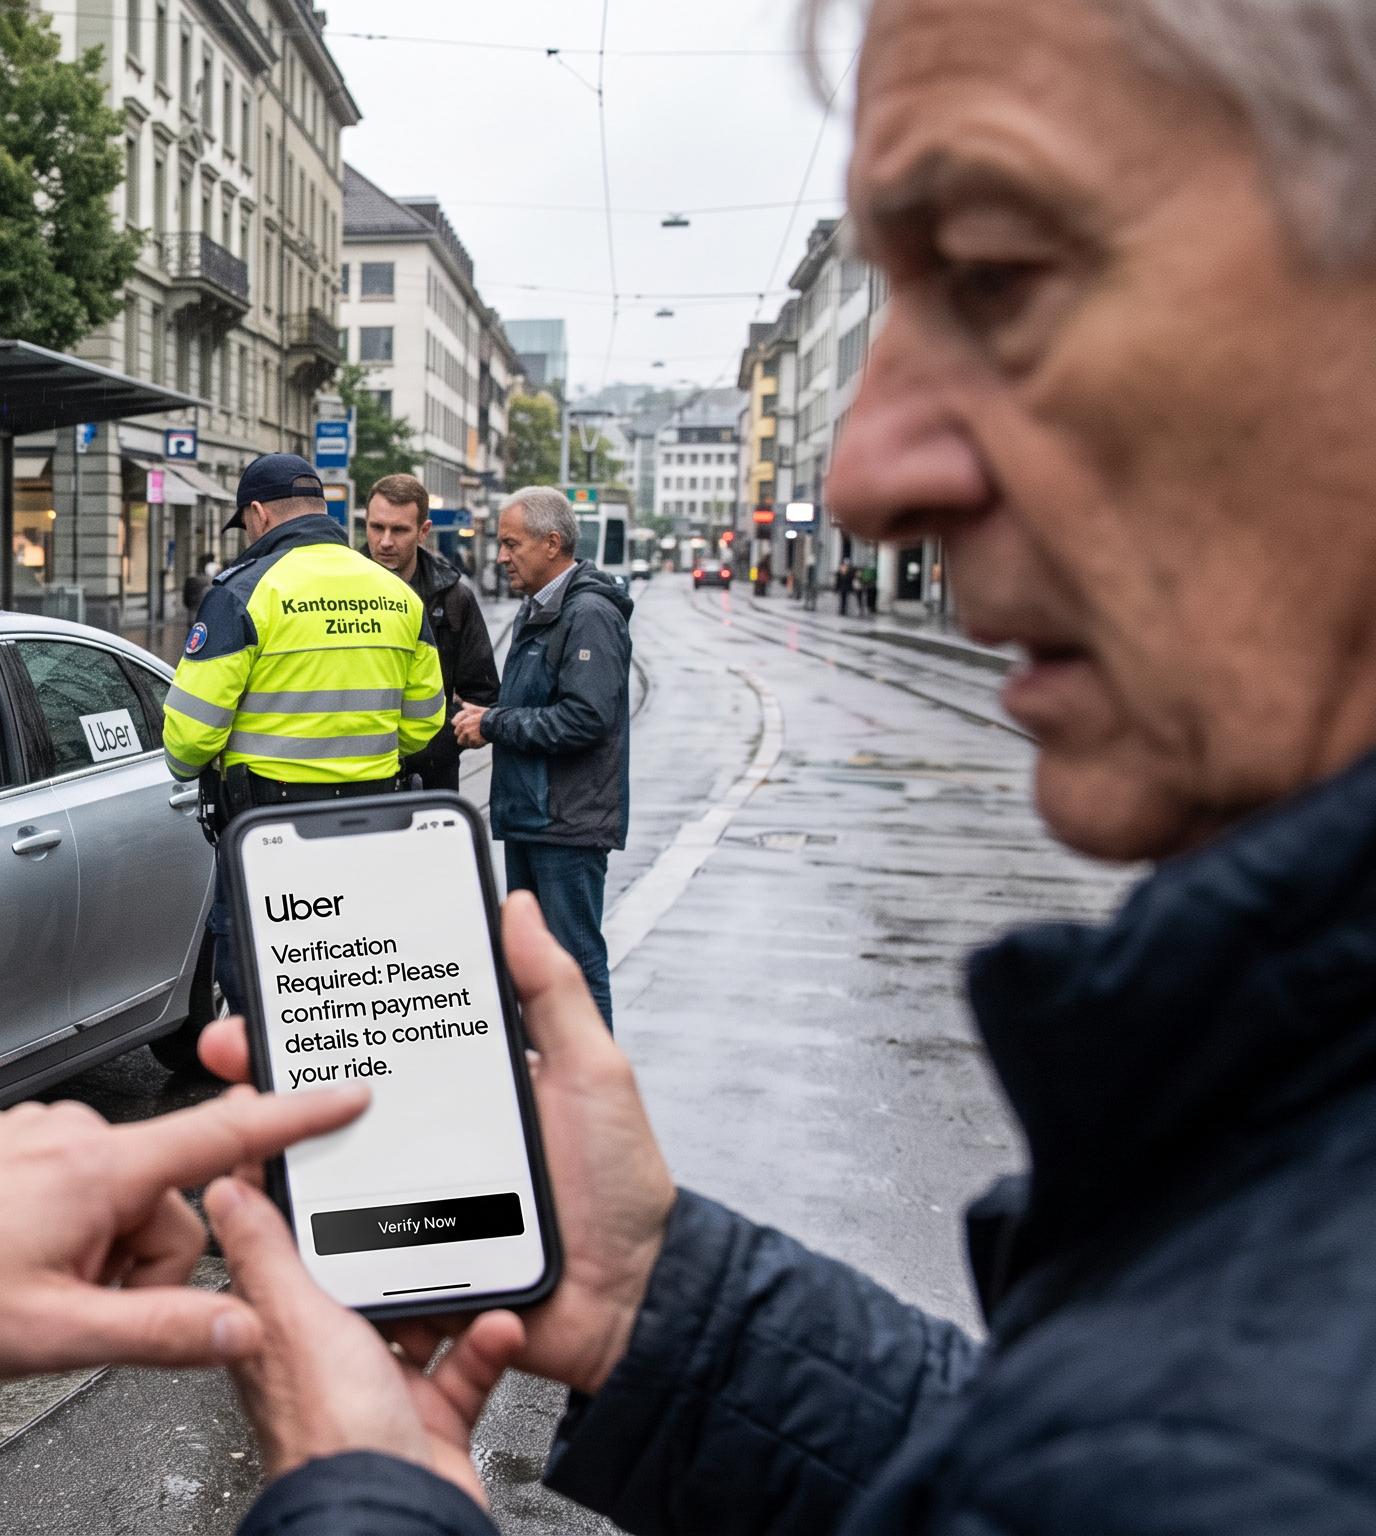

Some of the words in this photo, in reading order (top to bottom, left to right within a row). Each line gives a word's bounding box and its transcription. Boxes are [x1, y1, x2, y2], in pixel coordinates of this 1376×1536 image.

[281, 596, 408, 615] Kantonspolizei
[325, 618, 382, 634] Zürich
[87, 721, 132, 753] Uber
[264, 893, 344, 923] Uber
[271, 937, 397, 964] Verification
[276, 966, 384, 996] Required:
[386, 961, 460, 984] Please
[280, 1000, 367, 1024] confirm
[371, 988, 471, 1021] payment
[285, 1029, 360, 1054] details
[362, 1027, 387, 1046] to
[392, 1018, 489, 1044] continue
[288, 1063, 339, 1090] your
[344, 1056, 393, 1079] ride.
[377, 1217, 421, 1234] Verify
[424, 1216, 456, 1229] Now
